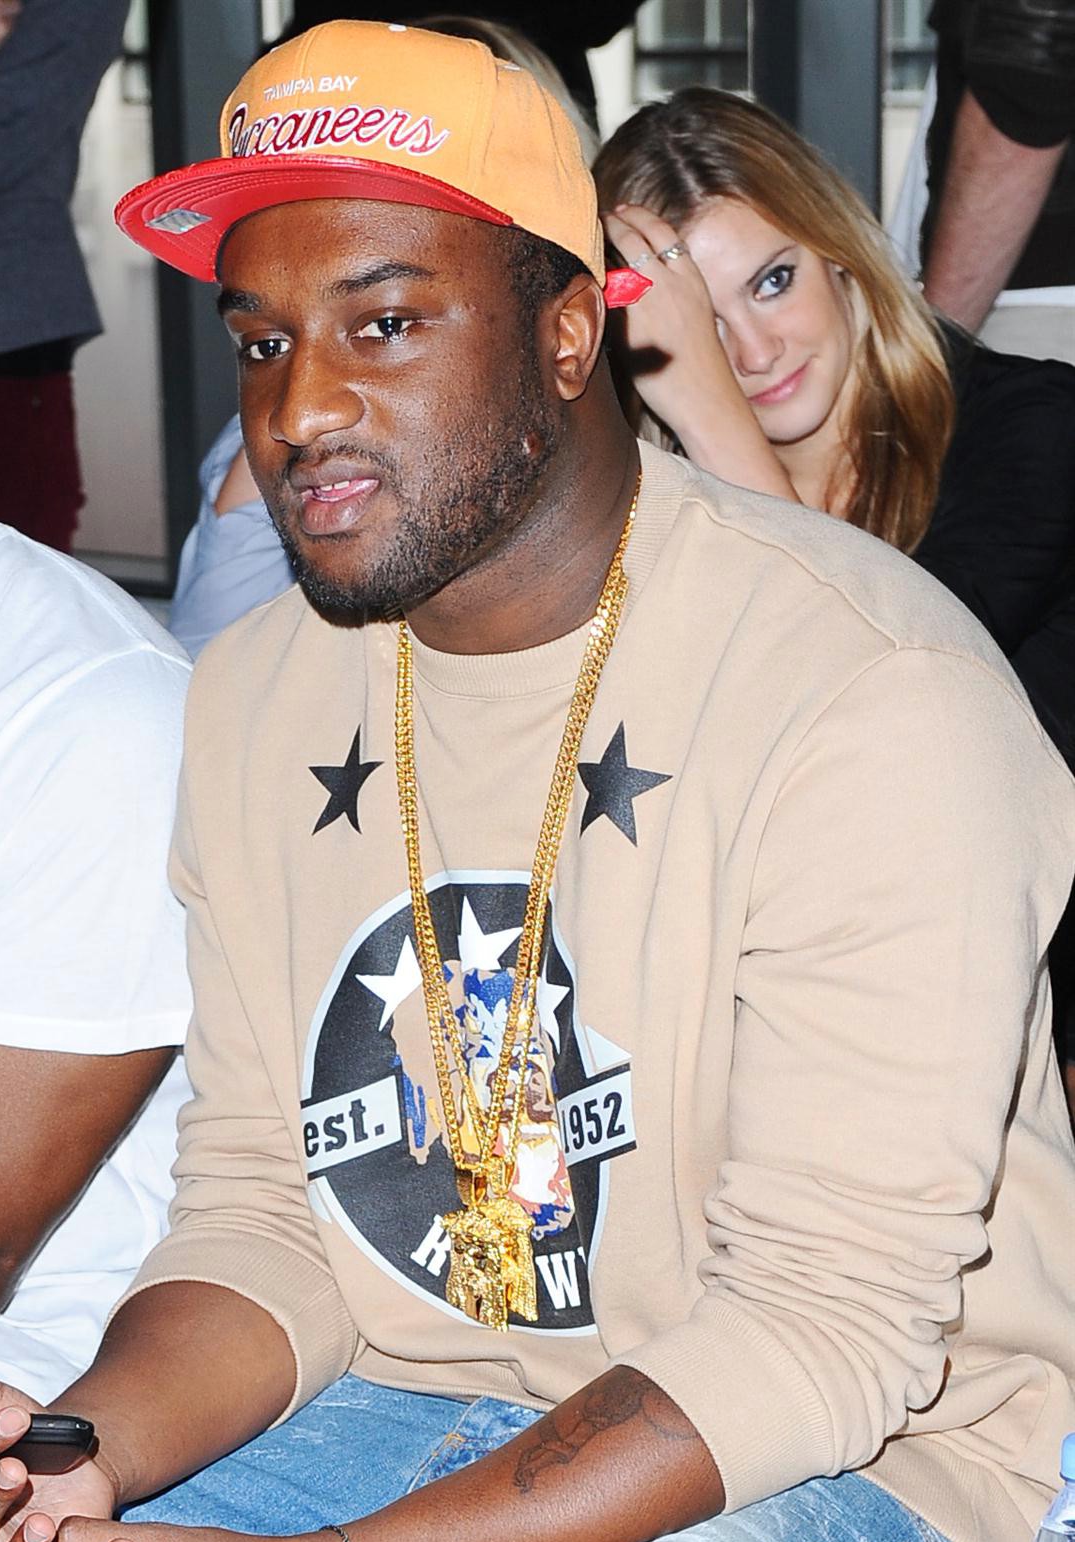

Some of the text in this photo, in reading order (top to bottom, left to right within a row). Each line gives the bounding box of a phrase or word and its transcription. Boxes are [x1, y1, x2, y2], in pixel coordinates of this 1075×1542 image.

[263, 74, 359, 101] TAMPA BAY
[303, 1098, 385, 1158] est.
